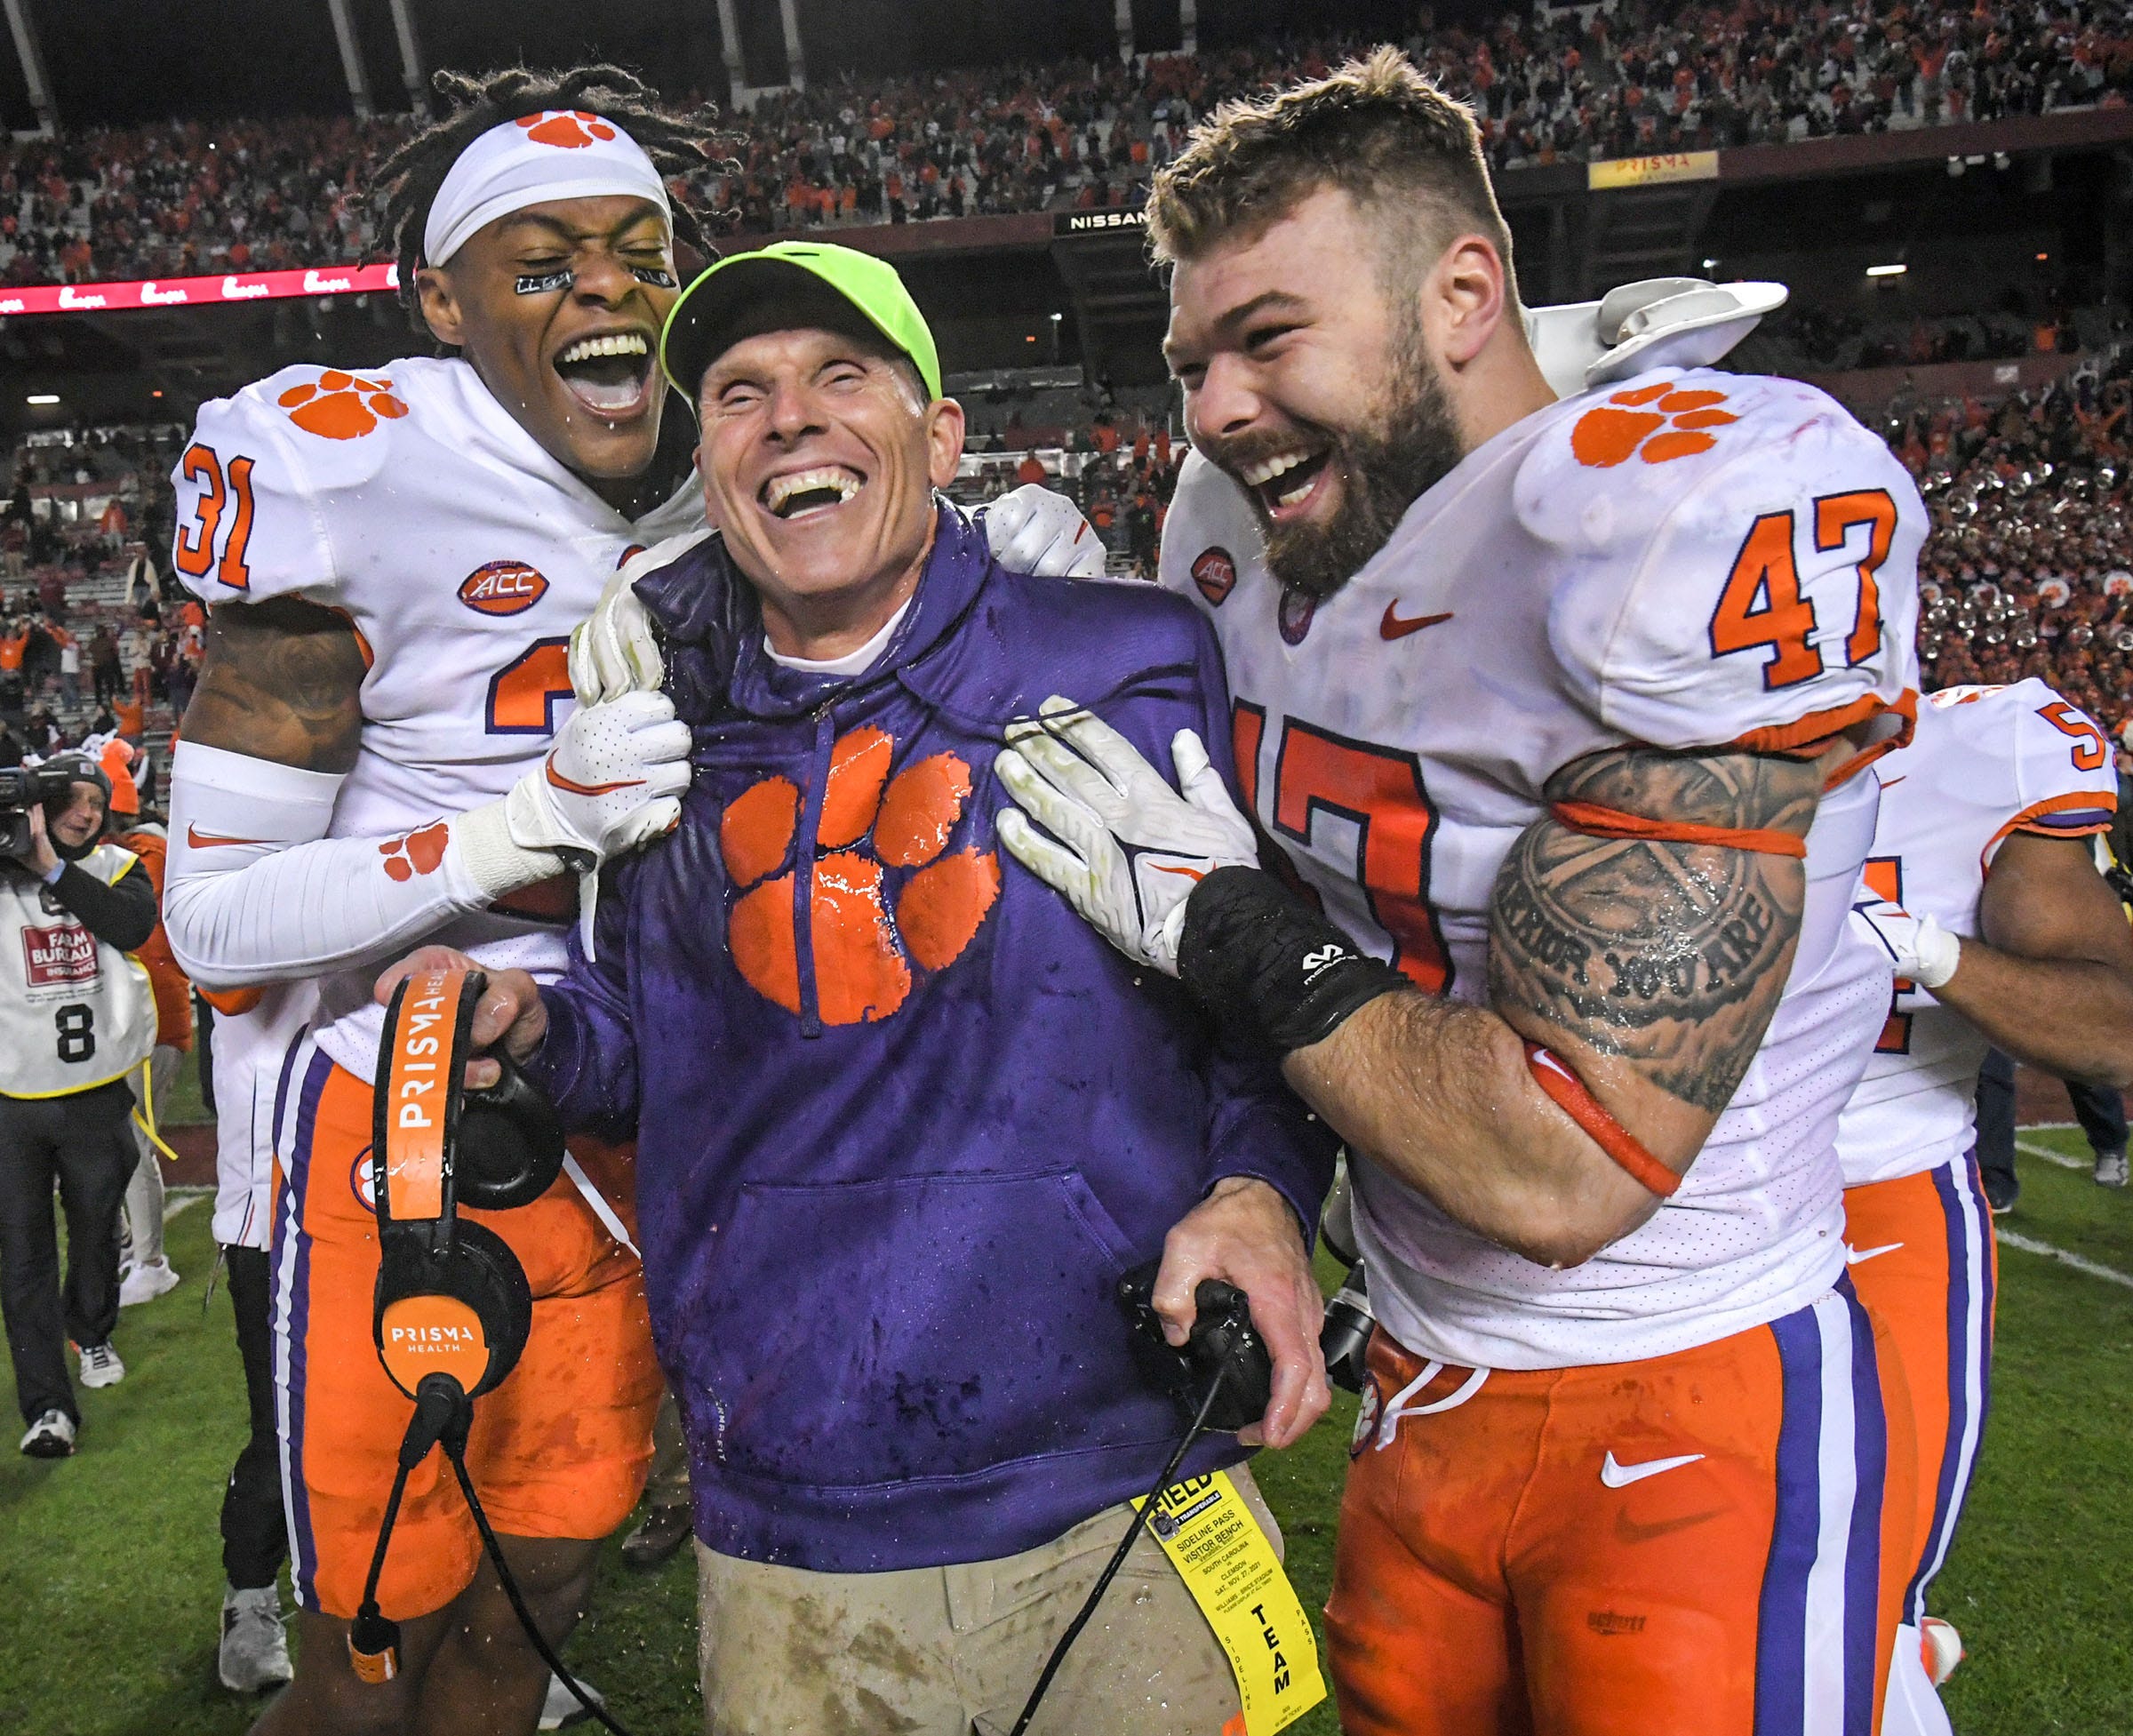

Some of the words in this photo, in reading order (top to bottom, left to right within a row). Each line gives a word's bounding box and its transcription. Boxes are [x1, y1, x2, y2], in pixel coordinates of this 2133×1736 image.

[1071, 212, 1151, 229] NISSAN
[177, 442, 256, 591] 31
[470, 572, 535, 597] ACC
[1198, 560, 1232, 583] ACC
[1707, 487, 1897, 692] 47
[48, 931, 88, 948] FARM
[55, 1003, 96, 1064] 8
[399, 996, 445, 1128] PRISMA
[391, 1327, 474, 1341] PRISMA
[408, 1343, 460, 1352] HEALTH
[1179, 1492, 1220, 1523] TRANSFERABLE
[1177, 1524, 1213, 1552] SIDELINE
[1212, 1509, 1235, 1528] PASS
[1183, 1539, 1215, 1564] VISITOR
[1214, 1519, 1244, 1543] BENCH
[1202, 1559, 1222, 1575] SOUTH
[1221, 1540, 1250, 1562] CAROLINA
[1220, 1560, 1247, 1580] CLEMSON
[1296, 1609, 1313, 1645] PASS
[1250, 1604, 1290, 1695] TEAM
[1225, 1636, 1251, 1711] SIDELINE
